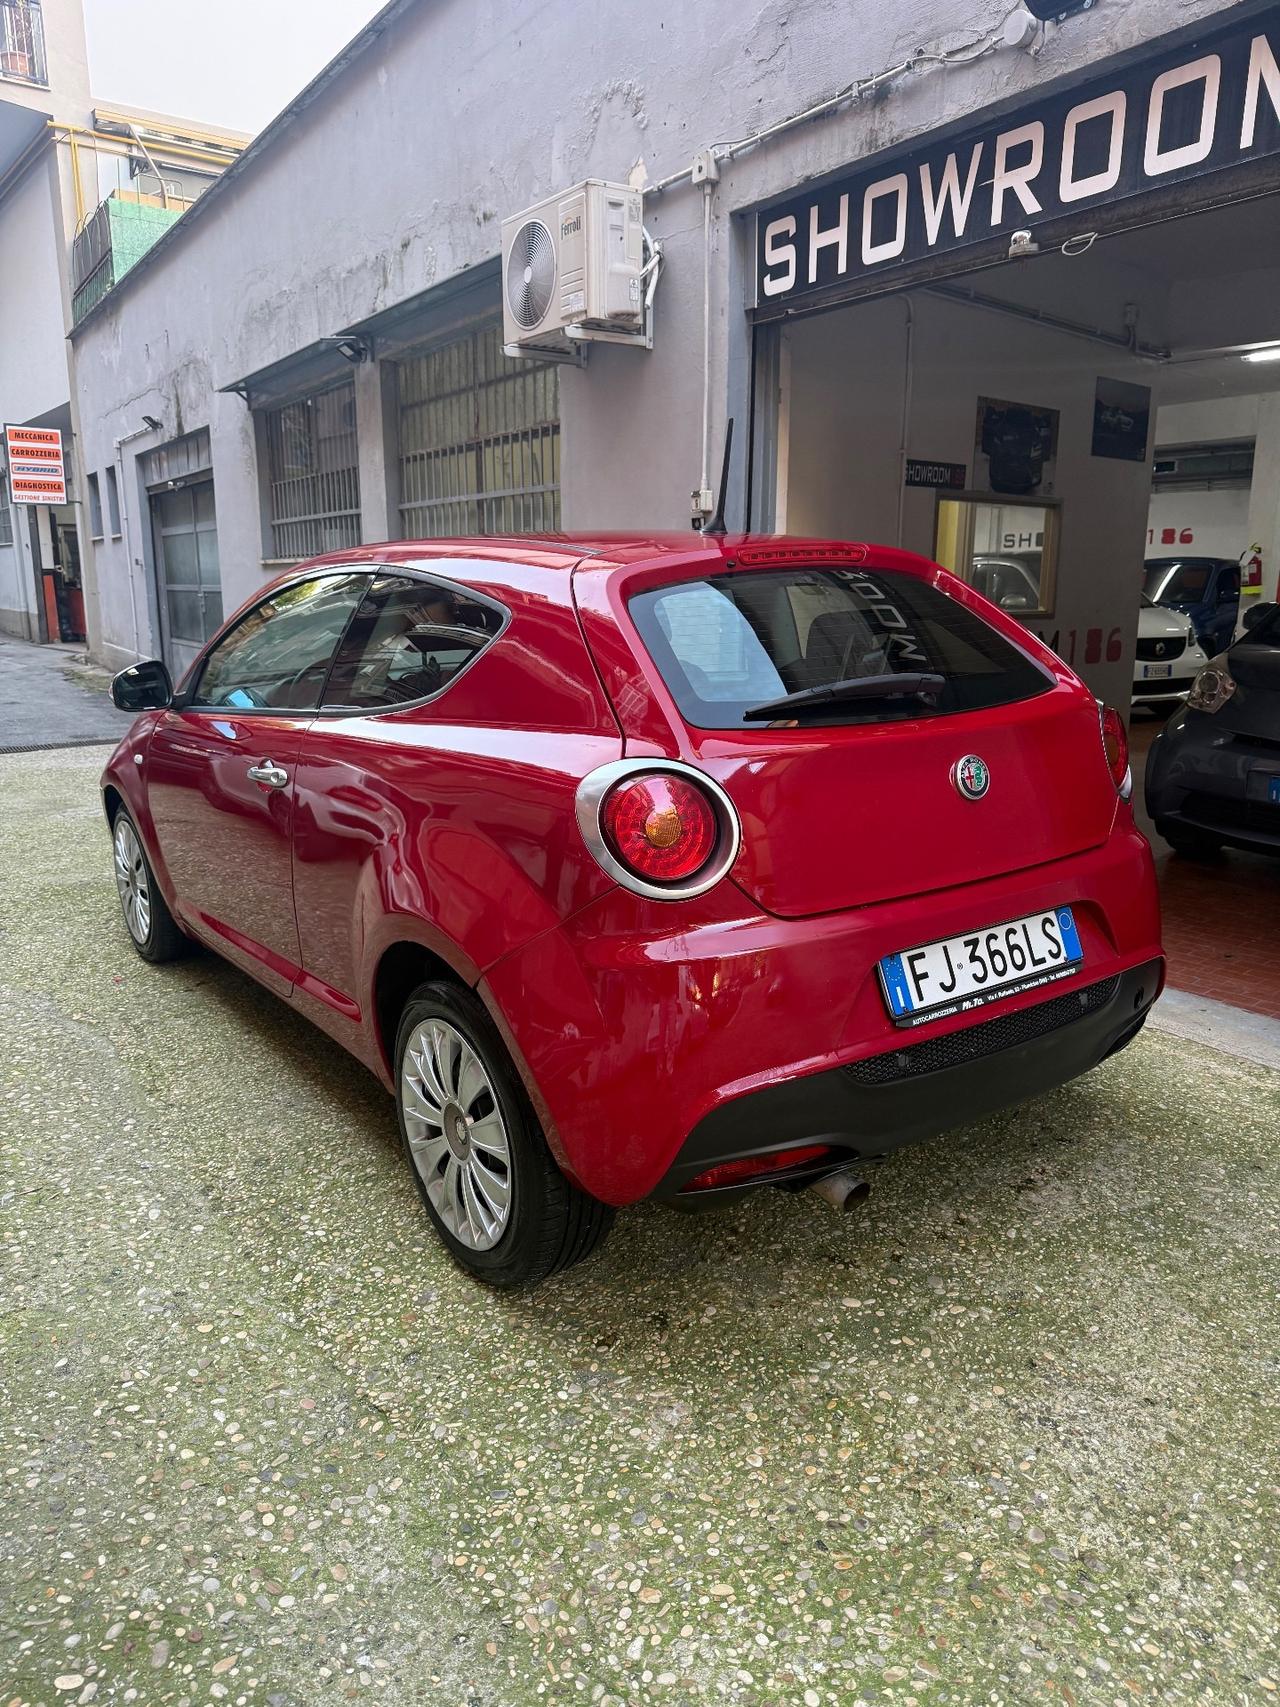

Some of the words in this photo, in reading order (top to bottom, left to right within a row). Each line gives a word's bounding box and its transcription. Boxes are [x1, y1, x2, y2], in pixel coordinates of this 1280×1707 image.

[561, 215, 581, 240] Ferroli
[14, 432, 54, 441] MECCANICA
[11, 448, 60, 458] CARROZZERIA
[15, 465, 59, 474] HYBRID
[15, 481, 62, 490] DIAGNOSTICA
[912, 1006, 958, 1026] AUTOCARROZZERIA
